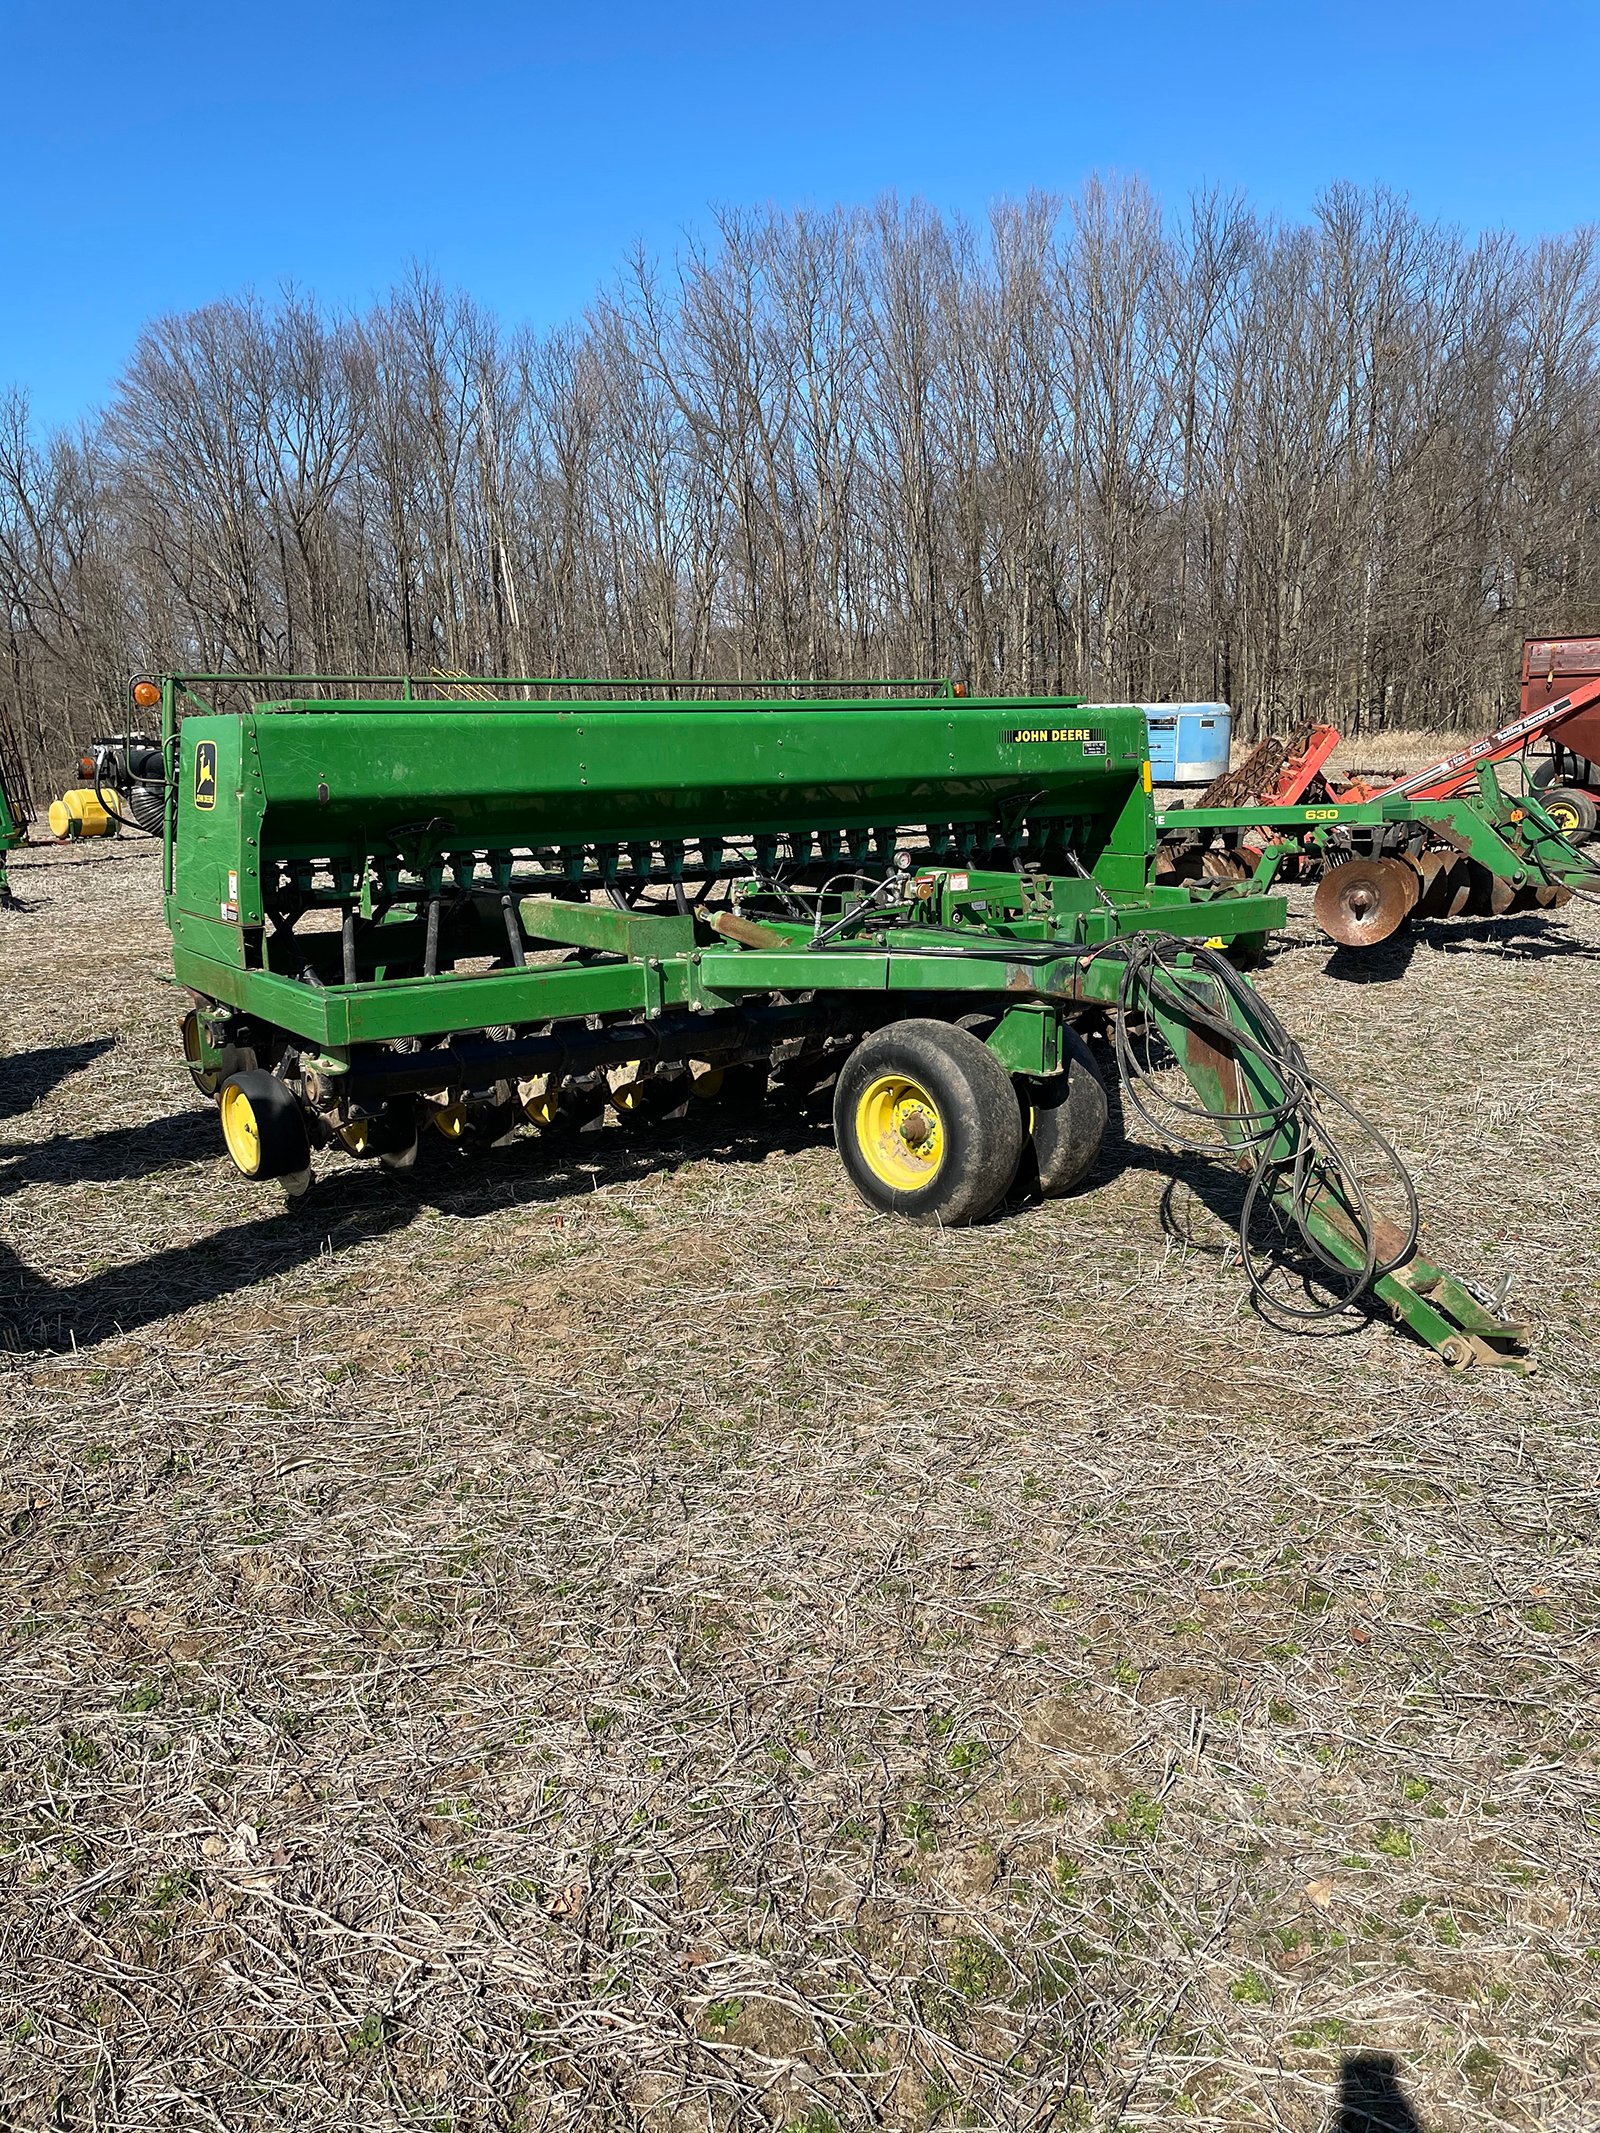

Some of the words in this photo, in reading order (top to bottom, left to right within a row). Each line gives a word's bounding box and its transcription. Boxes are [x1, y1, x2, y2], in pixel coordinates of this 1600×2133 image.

[1015, 730, 1047, 742] JOHN
[1052, 729, 1090, 741] DEERE
[1305, 809, 1339, 820] 630
